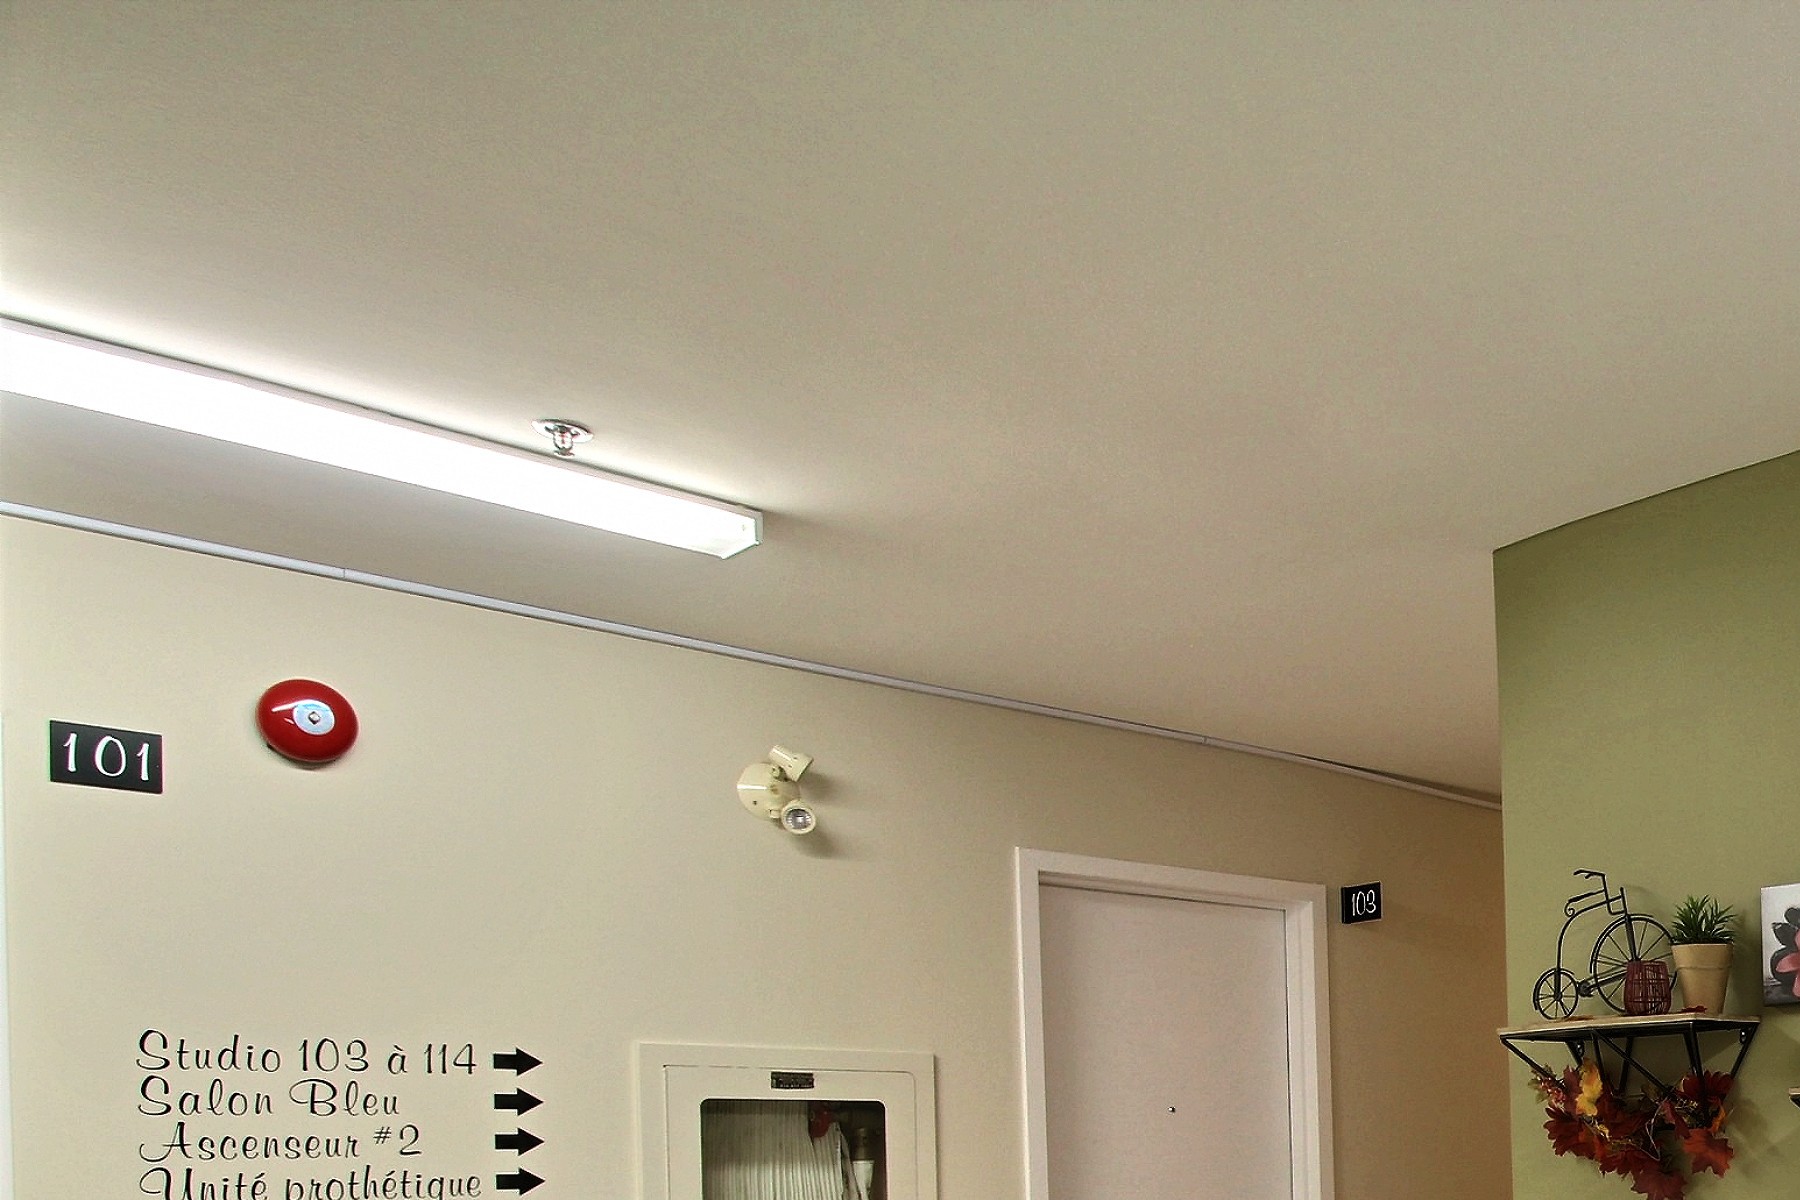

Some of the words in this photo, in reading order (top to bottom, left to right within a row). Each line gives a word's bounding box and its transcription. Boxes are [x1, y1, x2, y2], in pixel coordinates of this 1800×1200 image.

[63, 732, 150, 781] 101
[1351, 889, 1377, 917] 103
[136, 1029, 282, 1074] Studio
[298, 1037, 369, 1074] 103
[387, 1044, 408, 1075] à
[424, 1043, 478, 1075] 114
[137, 1075, 274, 1117] Salon
[289, 1078, 400, 1117] Bleu
[138, 1121, 361, 1163] Ascenseur
[373, 1123, 423, 1156] #2
